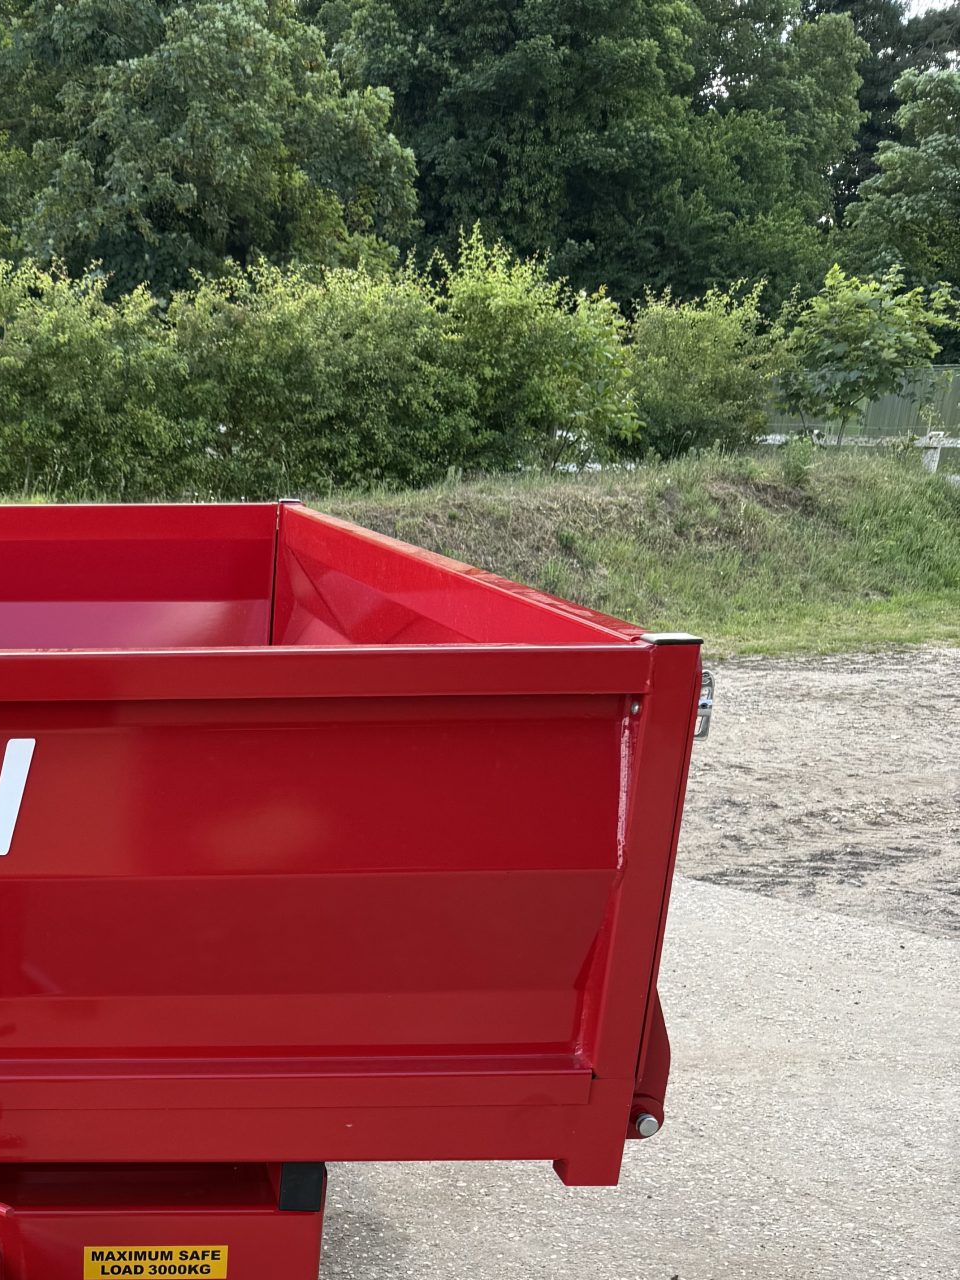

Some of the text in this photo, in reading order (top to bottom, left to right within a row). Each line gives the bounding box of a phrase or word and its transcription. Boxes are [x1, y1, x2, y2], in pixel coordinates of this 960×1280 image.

[91, 1250, 221, 1262] MAXIMUM SAFE
[100, 1263, 211, 1276] LOAD 3000KG
